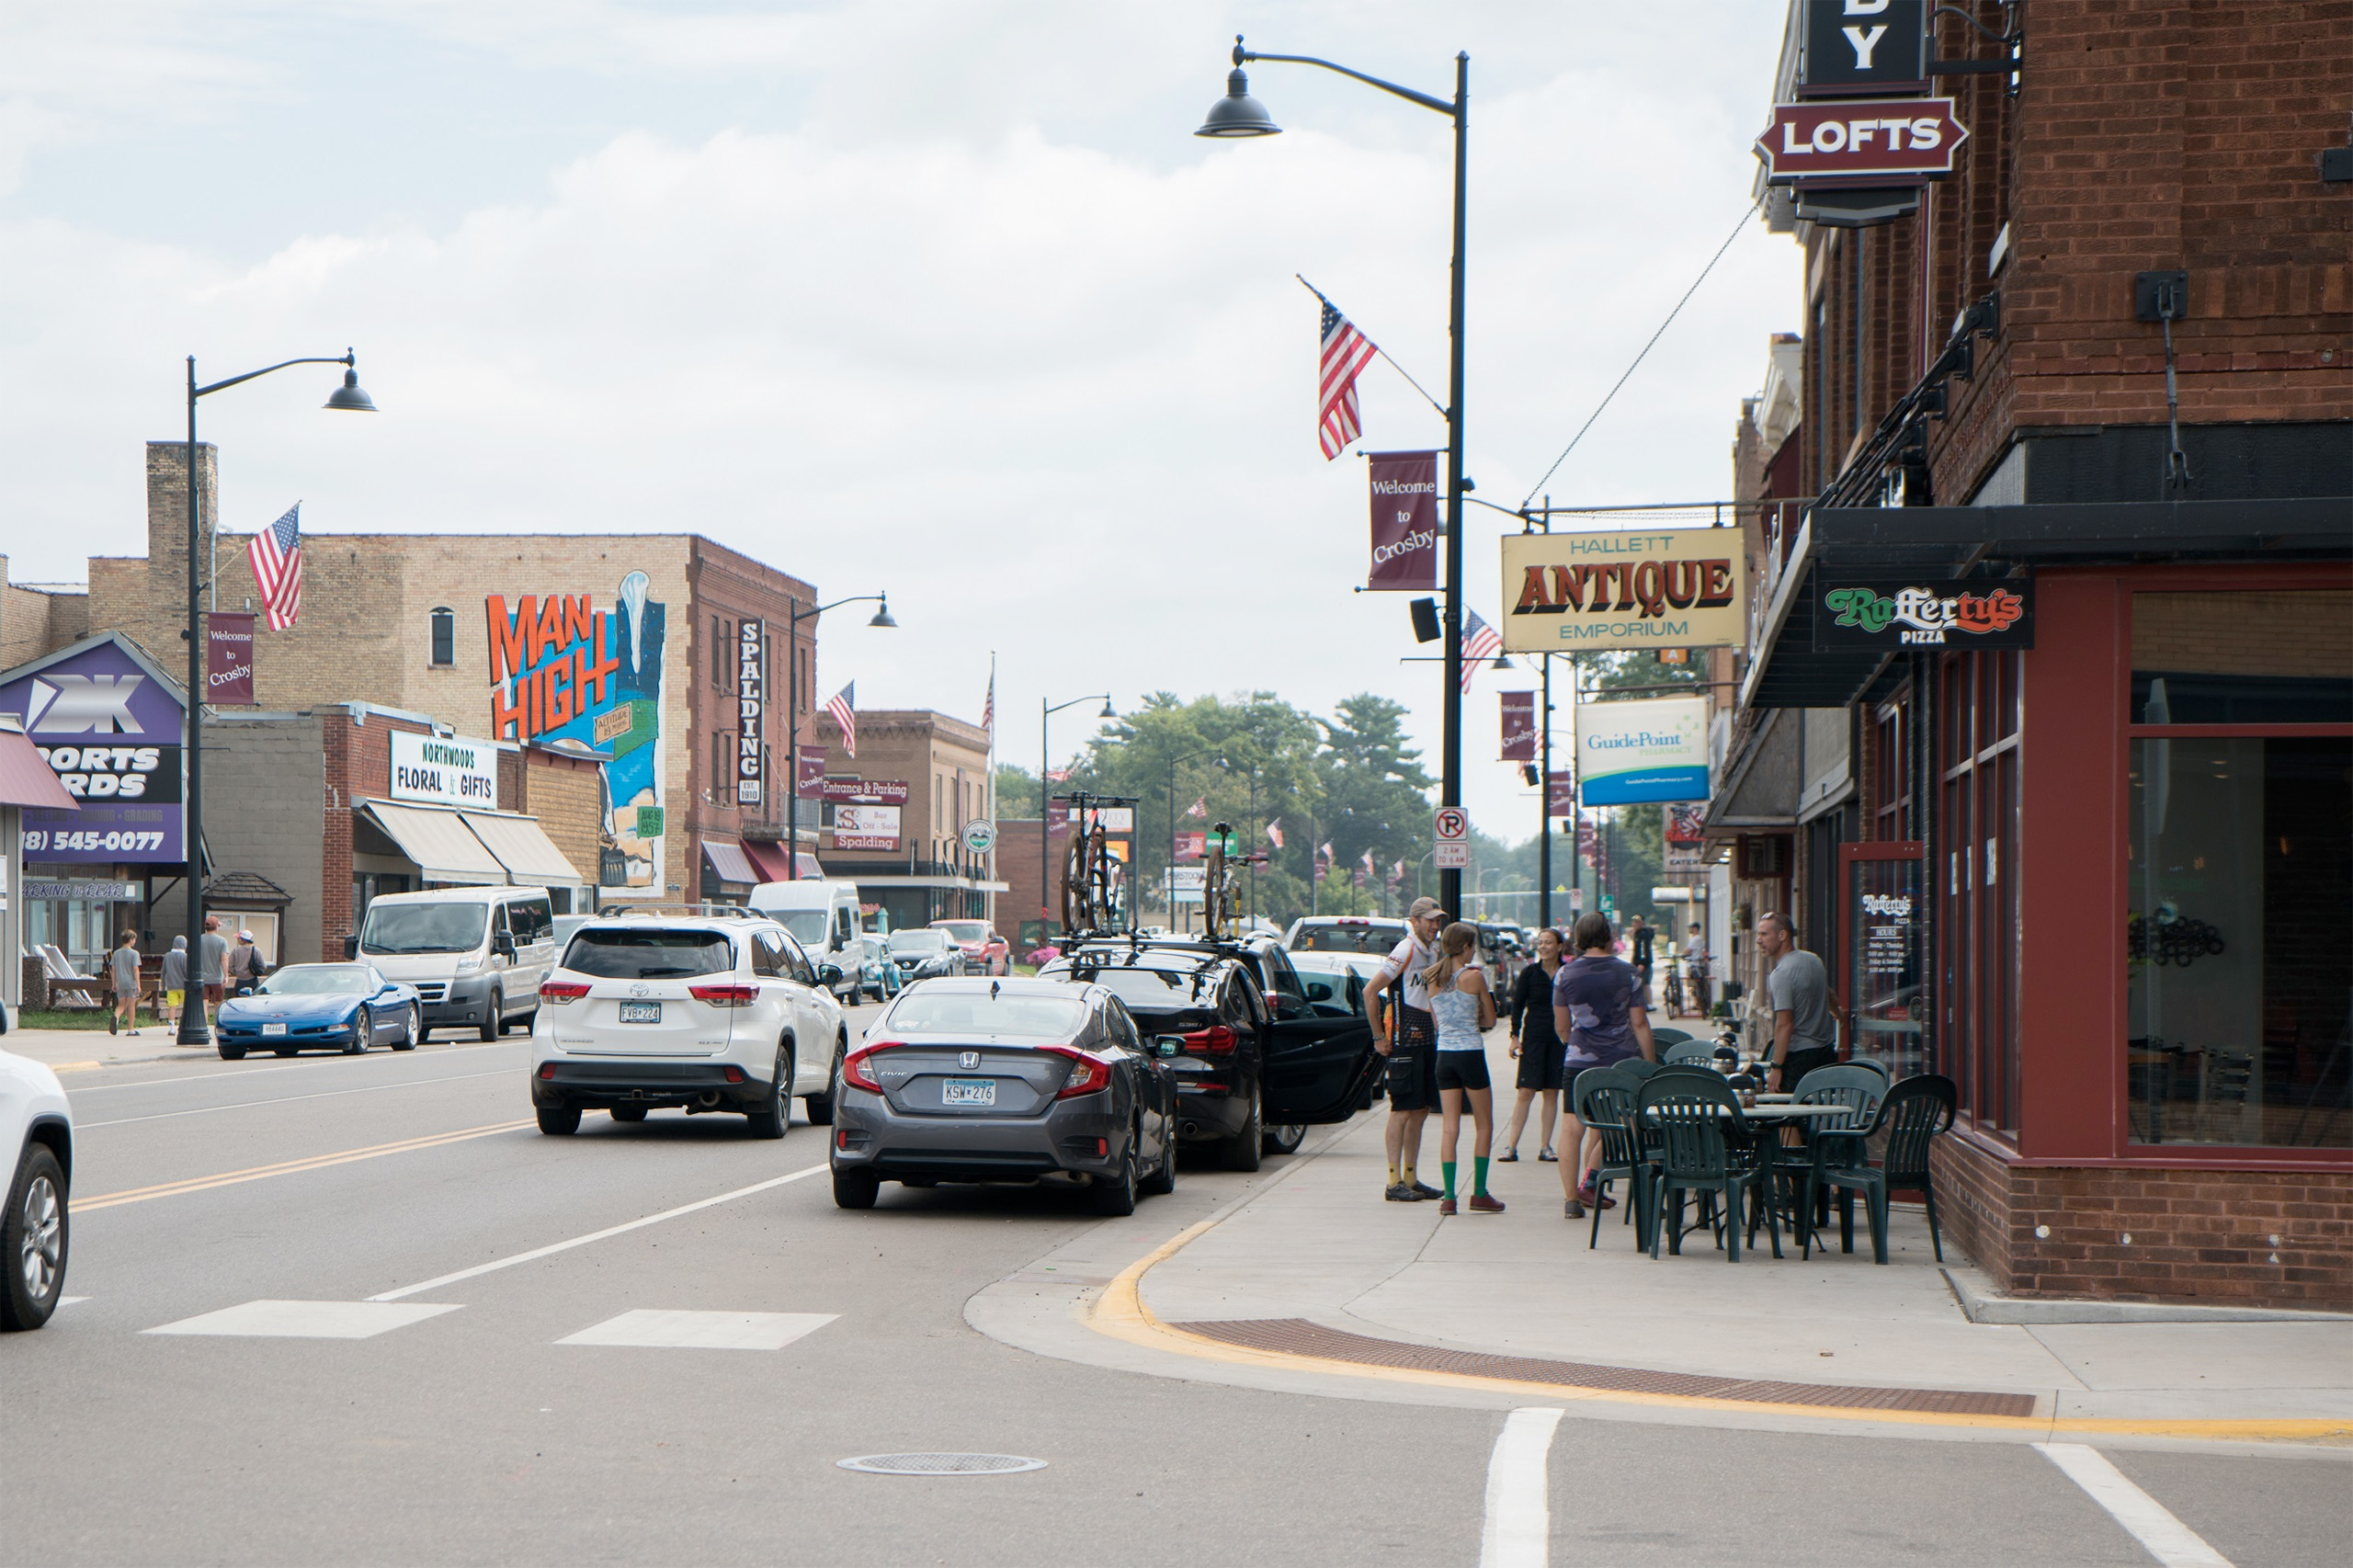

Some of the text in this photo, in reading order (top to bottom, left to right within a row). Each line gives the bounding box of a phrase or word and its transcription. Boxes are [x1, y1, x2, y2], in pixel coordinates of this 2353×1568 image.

[1782, 117, 1941, 154] LOFTS
[1371, 480, 1436, 494] Welcome
[1397, 510, 1411, 523] to
[1373, 528, 1435, 563] Crosby
[1570, 536, 1675, 555] HALLETT
[1511, 558, 1733, 619] ANTIQUE
[1825, 586, 2023, 633] Rafferty's
[210, 631, 252, 641] Welcome
[1560, 620, 1688, 640] EMPORIUM
[1901, 630, 1945, 644] PIZZA
[485, 593, 591, 687] MAN
[226, 651, 235, 659] to
[210, 664, 251, 686] Crosby
[491, 610, 620, 741] HIGH
[740, 623, 760, 775] SPALDING
[1502, 704, 1533, 712] Welcome
[598, 710, 628, 728] ALTITUDE
[1502, 730, 1533, 747] Crosby
[1588, 731, 1681, 749] GuidePoint
[422, 742, 474, 769] NORTHWOODS
[1639, 746, 1692, 756] PHARMACY
[801, 756, 825, 764] Welcome
[398, 767, 492, 799] FLORAL & GIFTS
[799, 776, 824, 789] Crosby
[823, 780, 907, 798] Entrance & Parking
[741, 790, 757, 800] 1910
[124, 809, 163, 822] GRADING
[641, 822, 660, 835] 1957
[53, 831, 164, 851] 545-0077
[838, 835, 893, 850] Spalding
[85, 883, 125, 898] REAR
[1862, 893, 1911, 916] Rafferty's
[1876, 928, 1896, 937] HOURS
[621, 1007, 658, 1019] FVB 224
[946, 1085, 993, 1099] KSW 276
